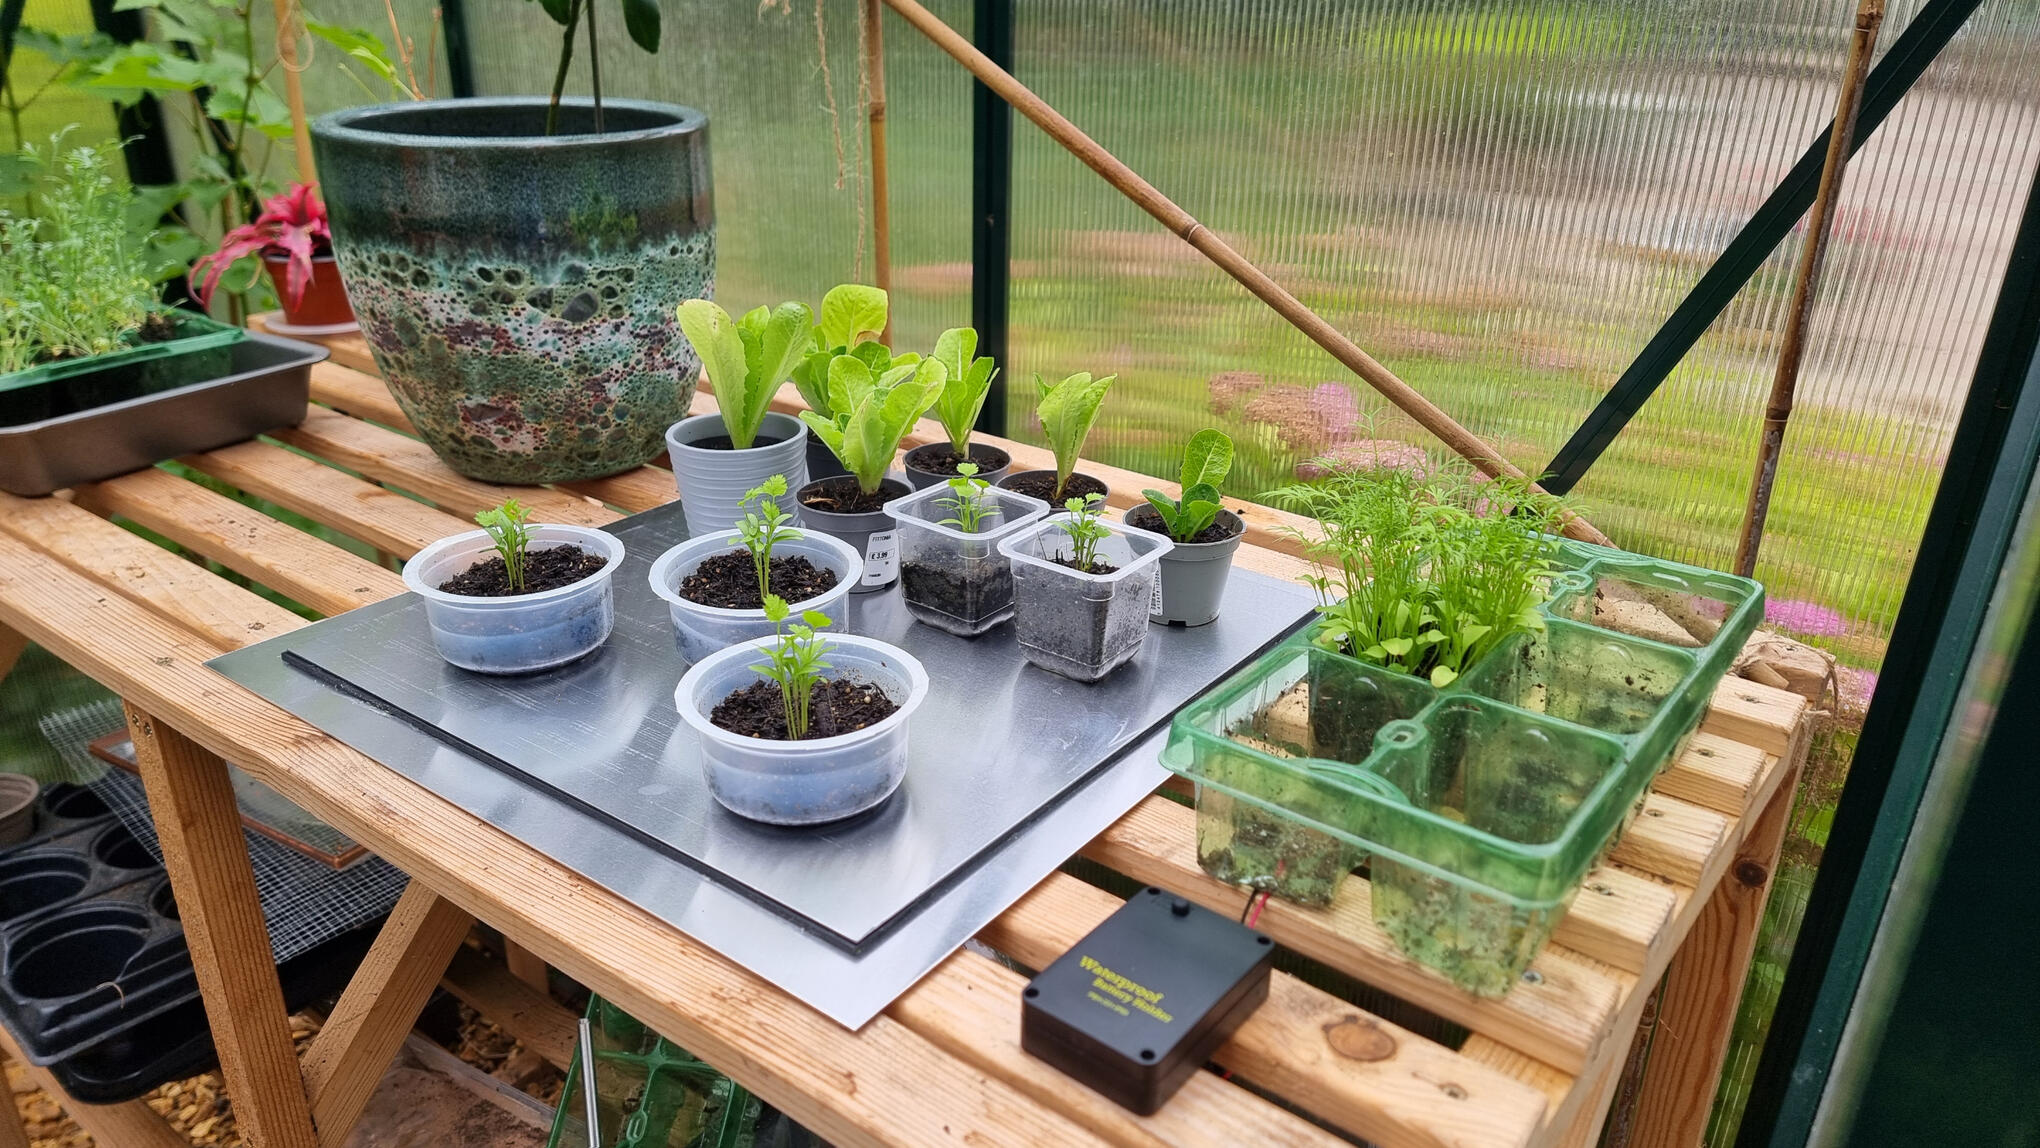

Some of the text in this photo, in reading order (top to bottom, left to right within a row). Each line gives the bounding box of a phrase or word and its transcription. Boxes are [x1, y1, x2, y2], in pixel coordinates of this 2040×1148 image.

[1080, 955, 1165, 1004] Waterproof
[1092, 977, 1134, 1004] Battery
[1132, 997, 1173, 1023] Holder
